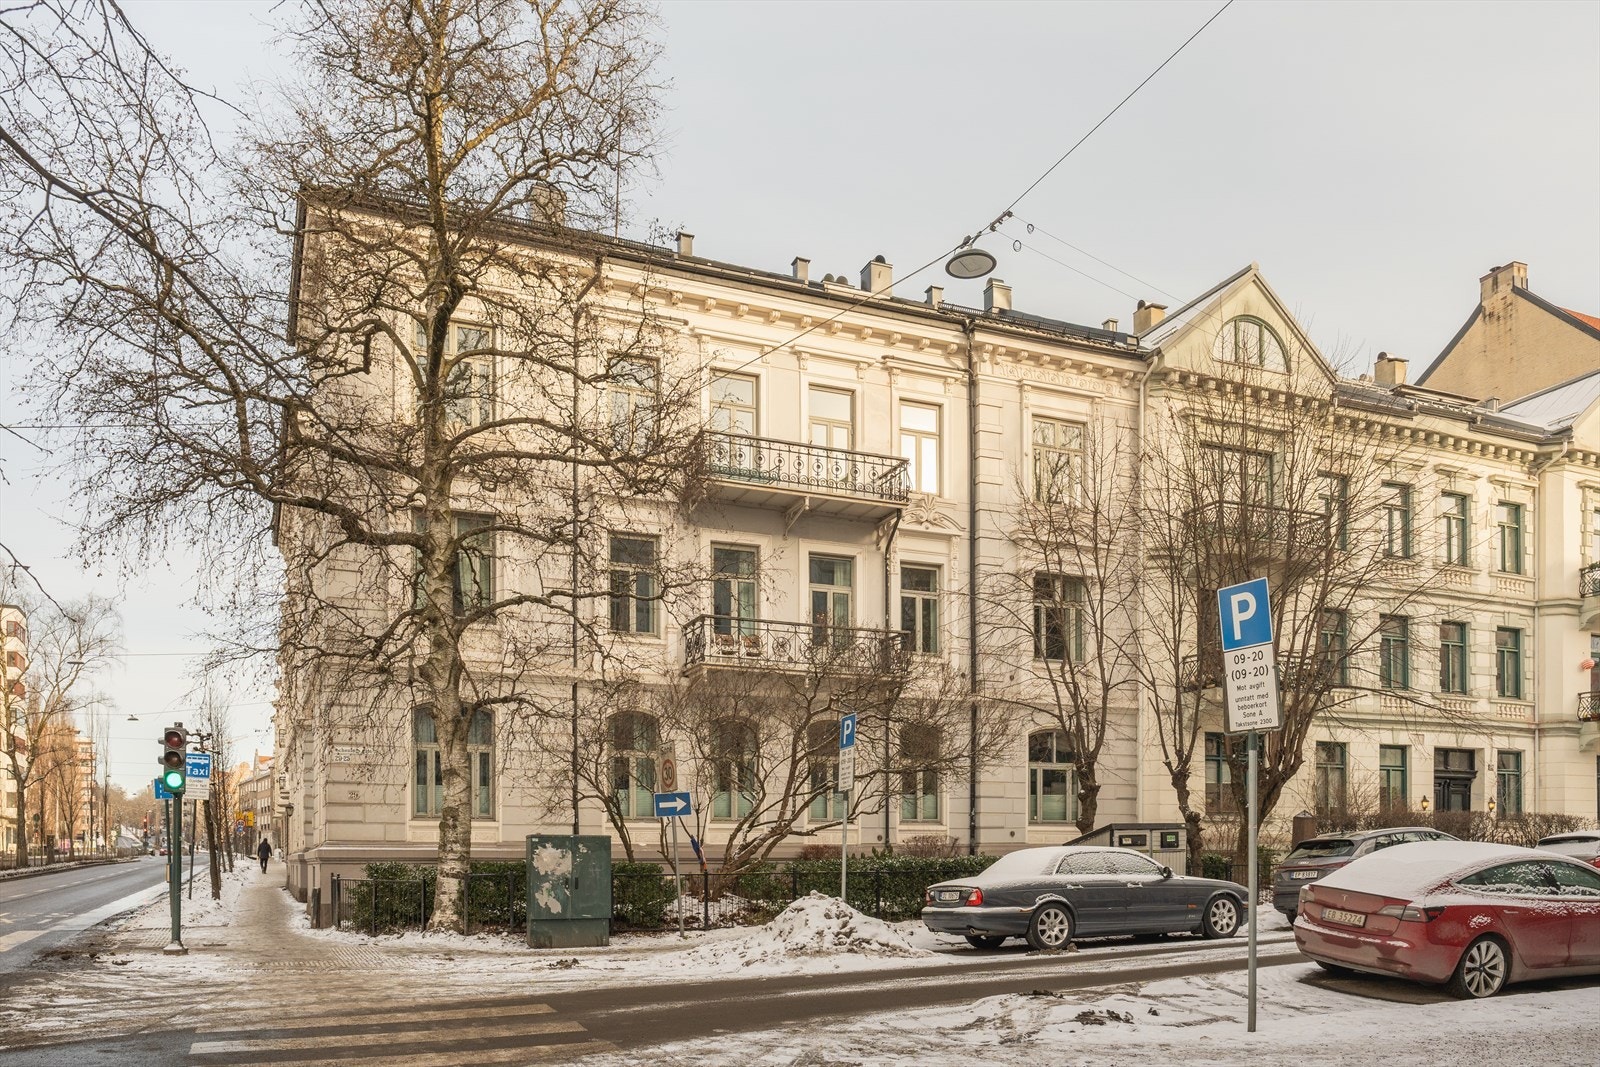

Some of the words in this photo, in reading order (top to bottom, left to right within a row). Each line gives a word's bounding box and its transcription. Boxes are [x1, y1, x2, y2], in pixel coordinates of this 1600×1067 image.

[1230, 591, 1257, 641] P
[1233, 650, 1264, 665] 09-20
[1231, 664, 1269, 682] (09-20)
[1236, 684, 1247, 692] Mot
[1249, 681, 1265, 692] avgift
[1235, 694, 1255, 703] unntatt
[1257, 692, 1269, 700] med
[1237, 700, 1267, 711] beboerkort
[1242, 711, 1256, 719] Sone
[1258, 709, 1263, 717] A
[1235, 720, 1258, 728] Takstsone
[1259, 717, 1273, 725] 2300
[843, 719, 853, 745] P
[186, 766, 209, 776] Taxi
[663, 764, 673, 780] 30
[1327, 910, 1337, 919] EB
[1338, 911, 1362, 924] 35274
